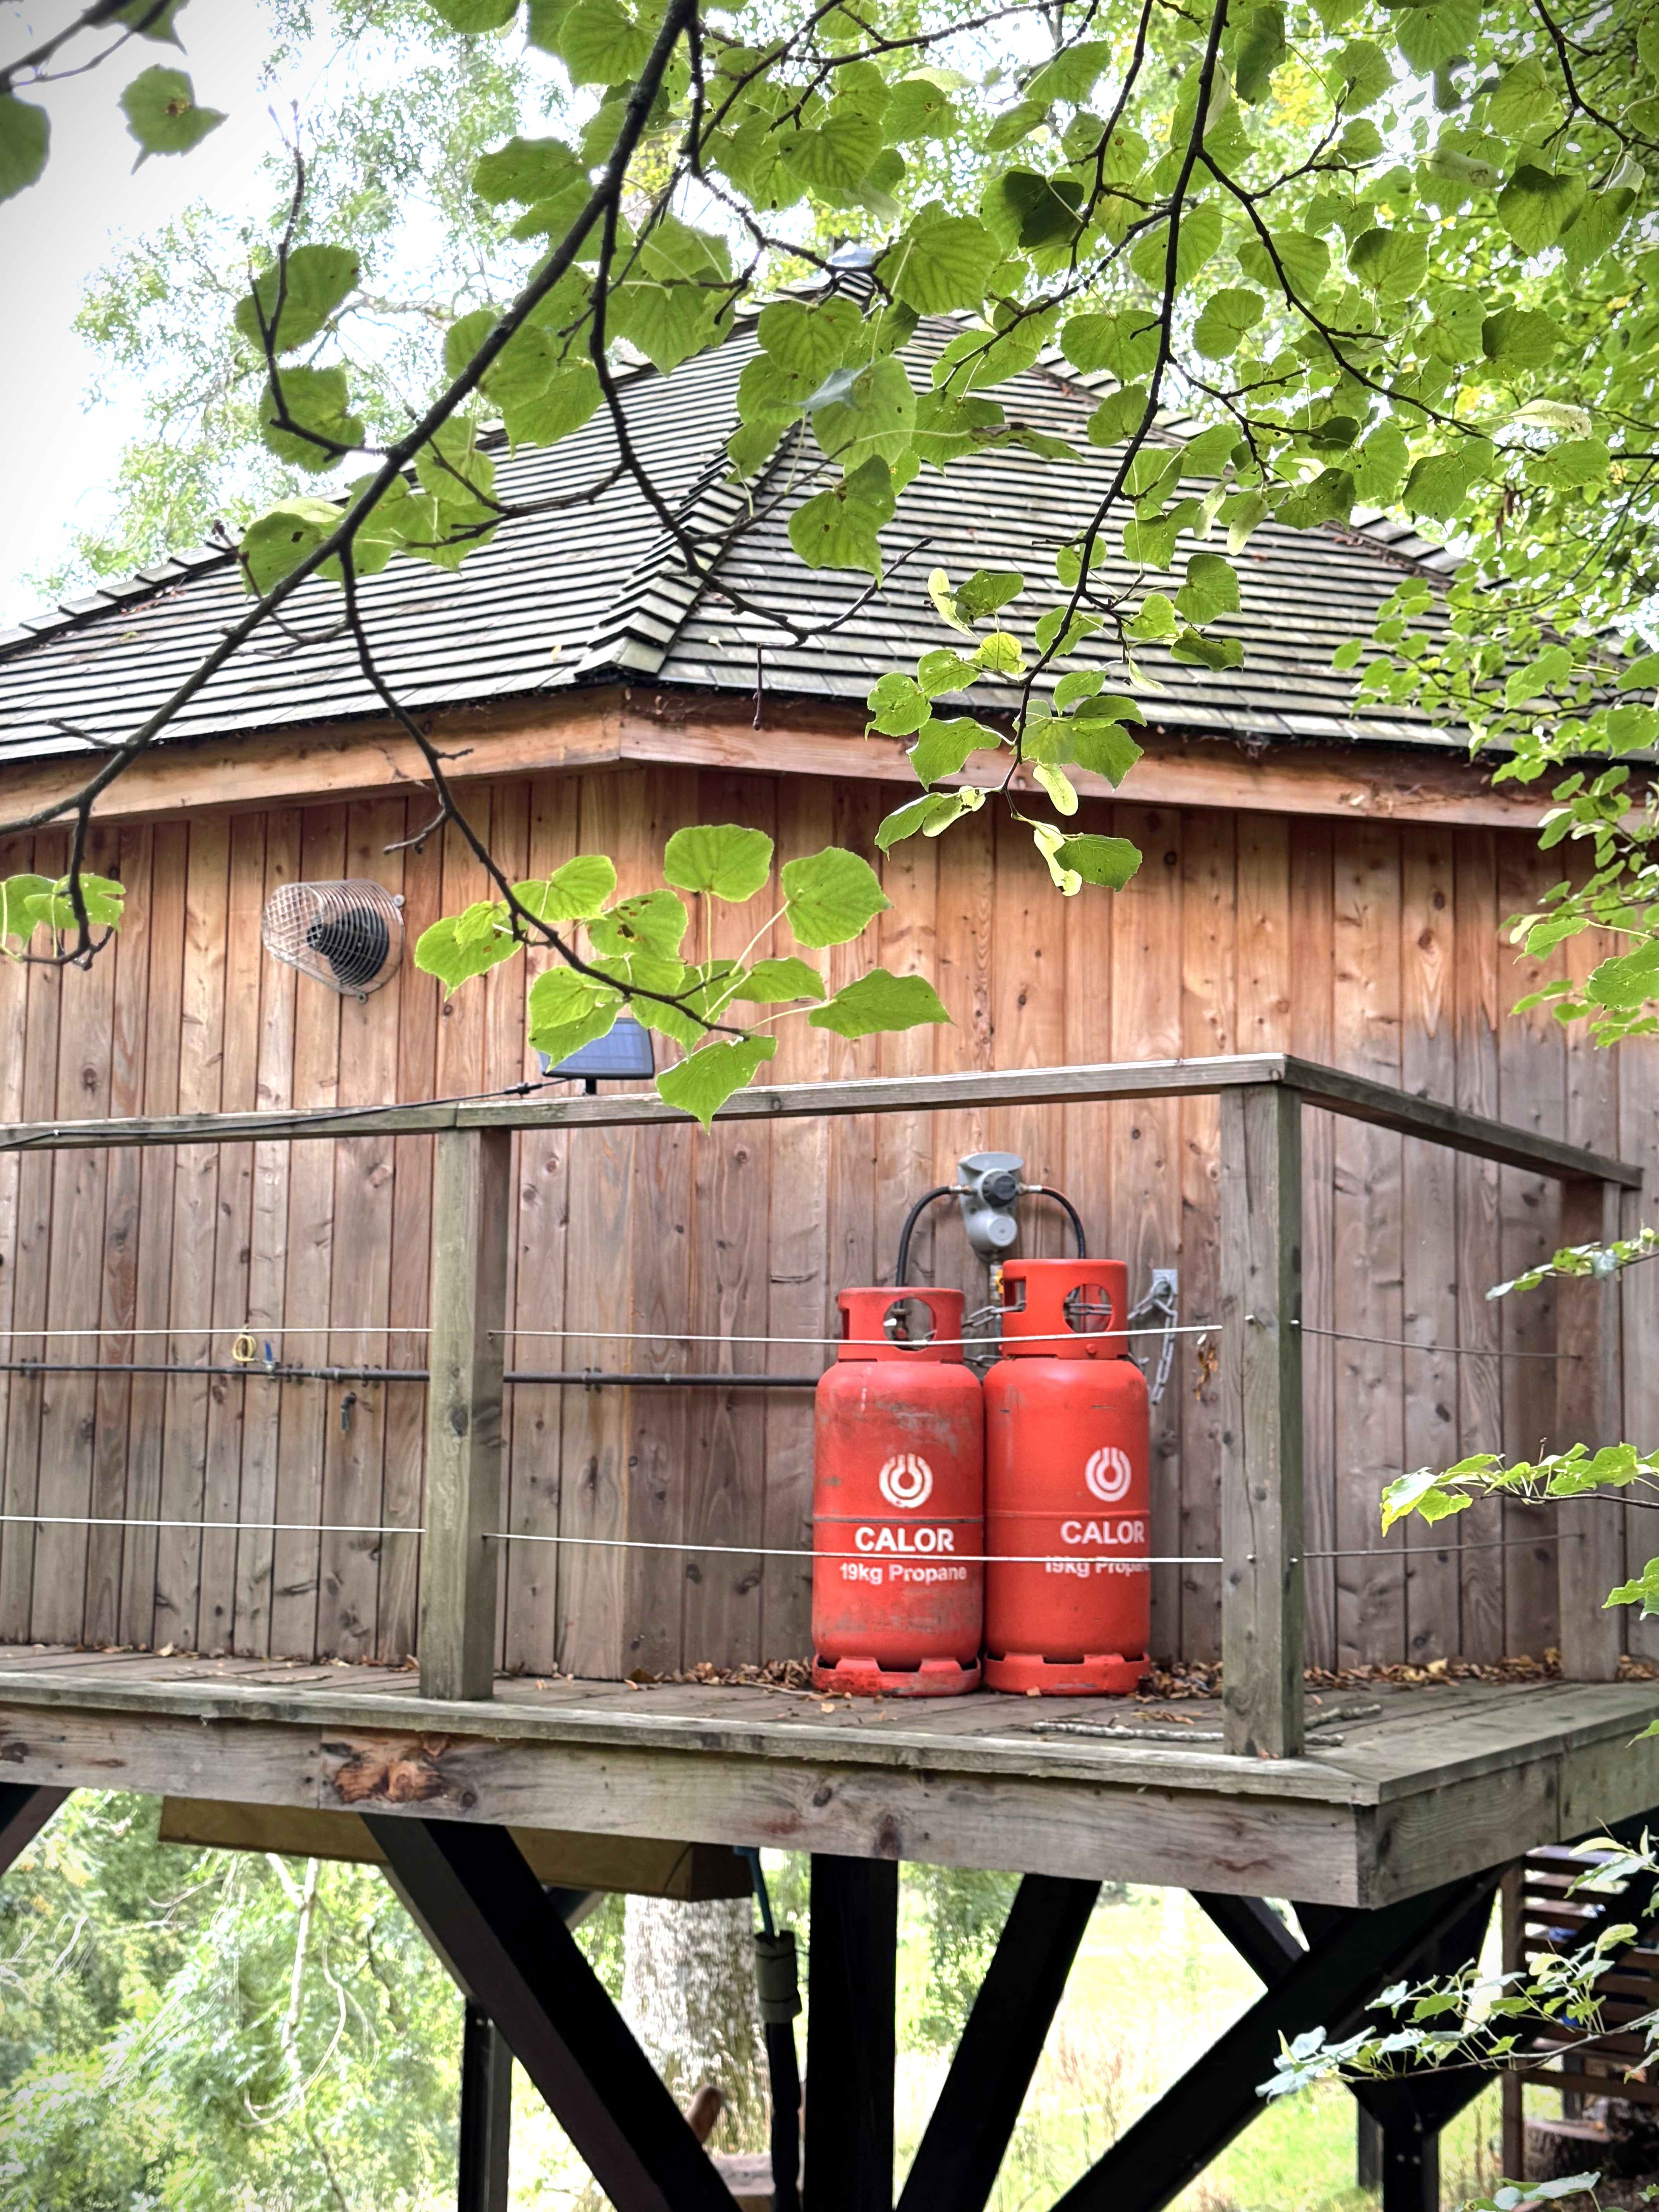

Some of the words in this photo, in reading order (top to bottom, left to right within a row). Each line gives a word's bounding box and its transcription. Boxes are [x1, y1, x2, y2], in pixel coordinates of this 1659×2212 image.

[855, 1527, 955, 1552] CALOR
[1060, 1520, 1145, 1544] CALOR
[840, 1562, 883, 1585] 19kg
[888, 1563, 967, 1585] Propane
